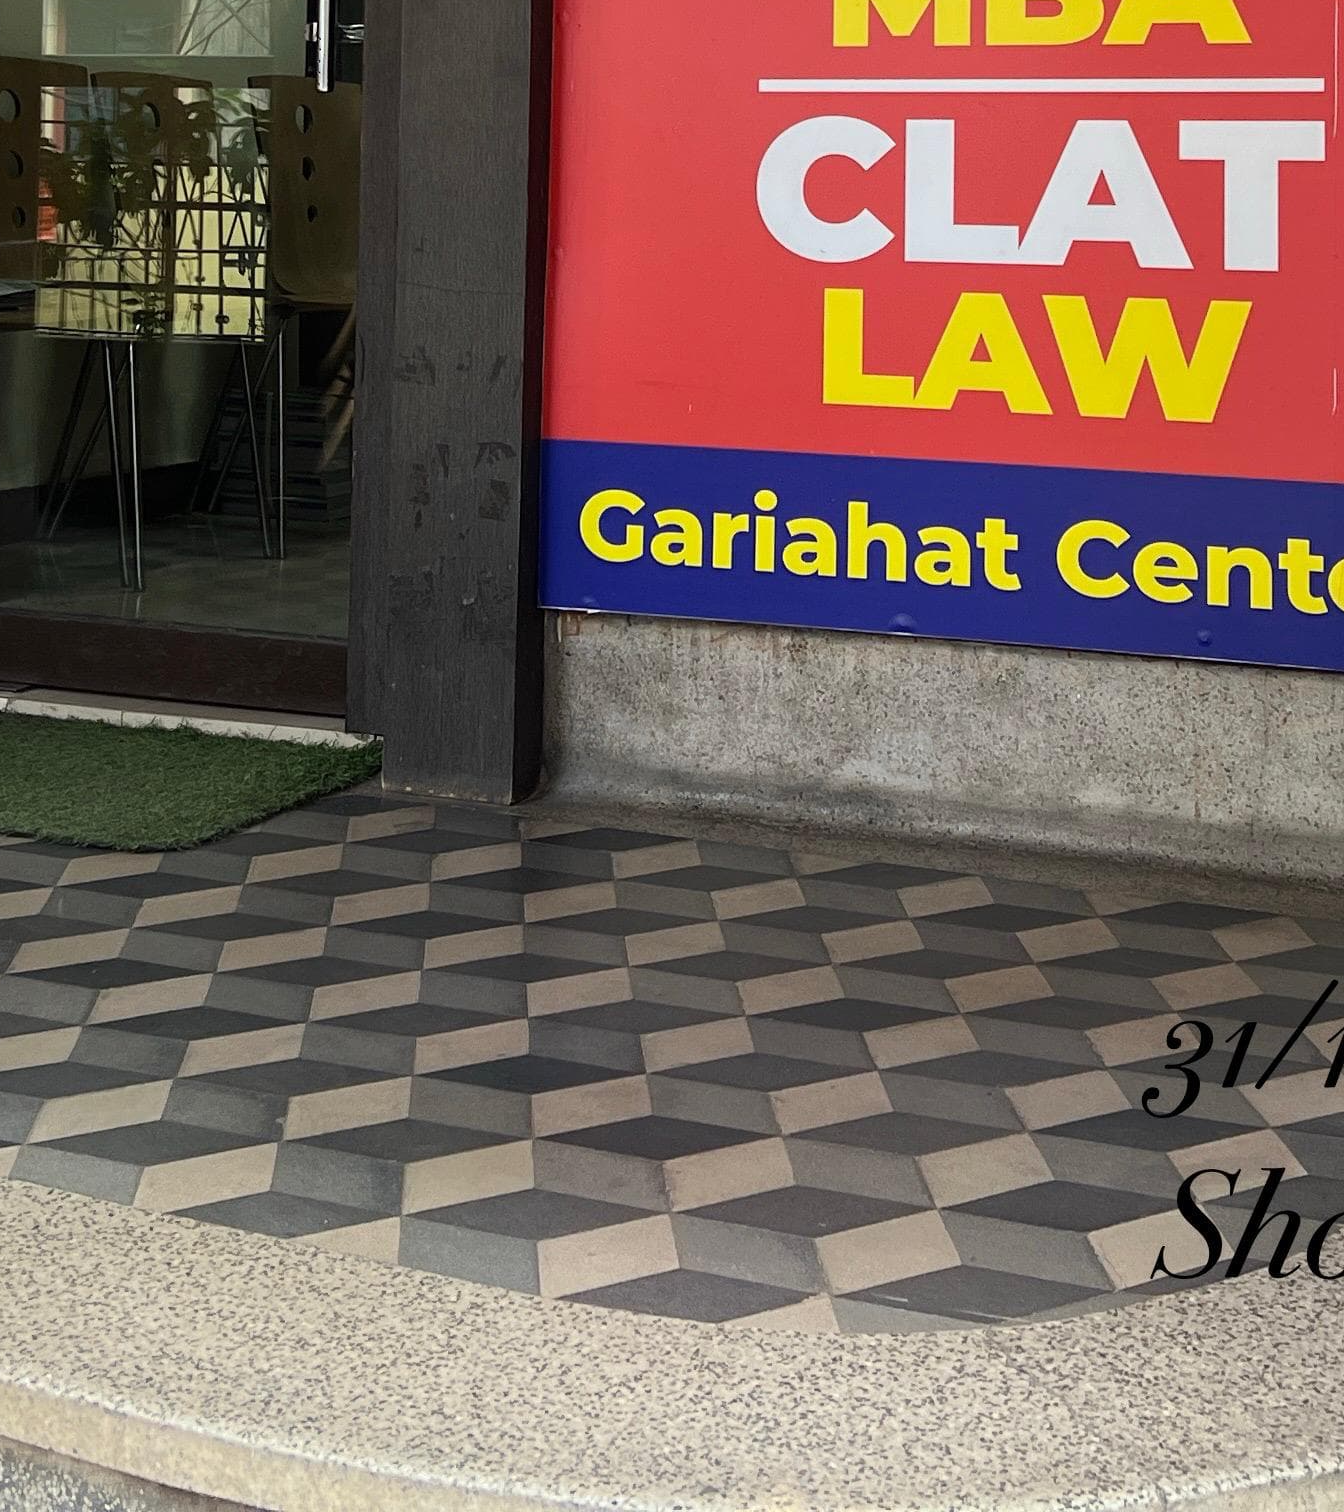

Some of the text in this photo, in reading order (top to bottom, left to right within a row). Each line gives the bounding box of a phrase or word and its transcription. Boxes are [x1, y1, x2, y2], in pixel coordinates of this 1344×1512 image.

[755, 115, 1326, 272] CLAT
[822, 287, 1253, 423] LAW
[581, 489, 1019, 589] Gariahat
